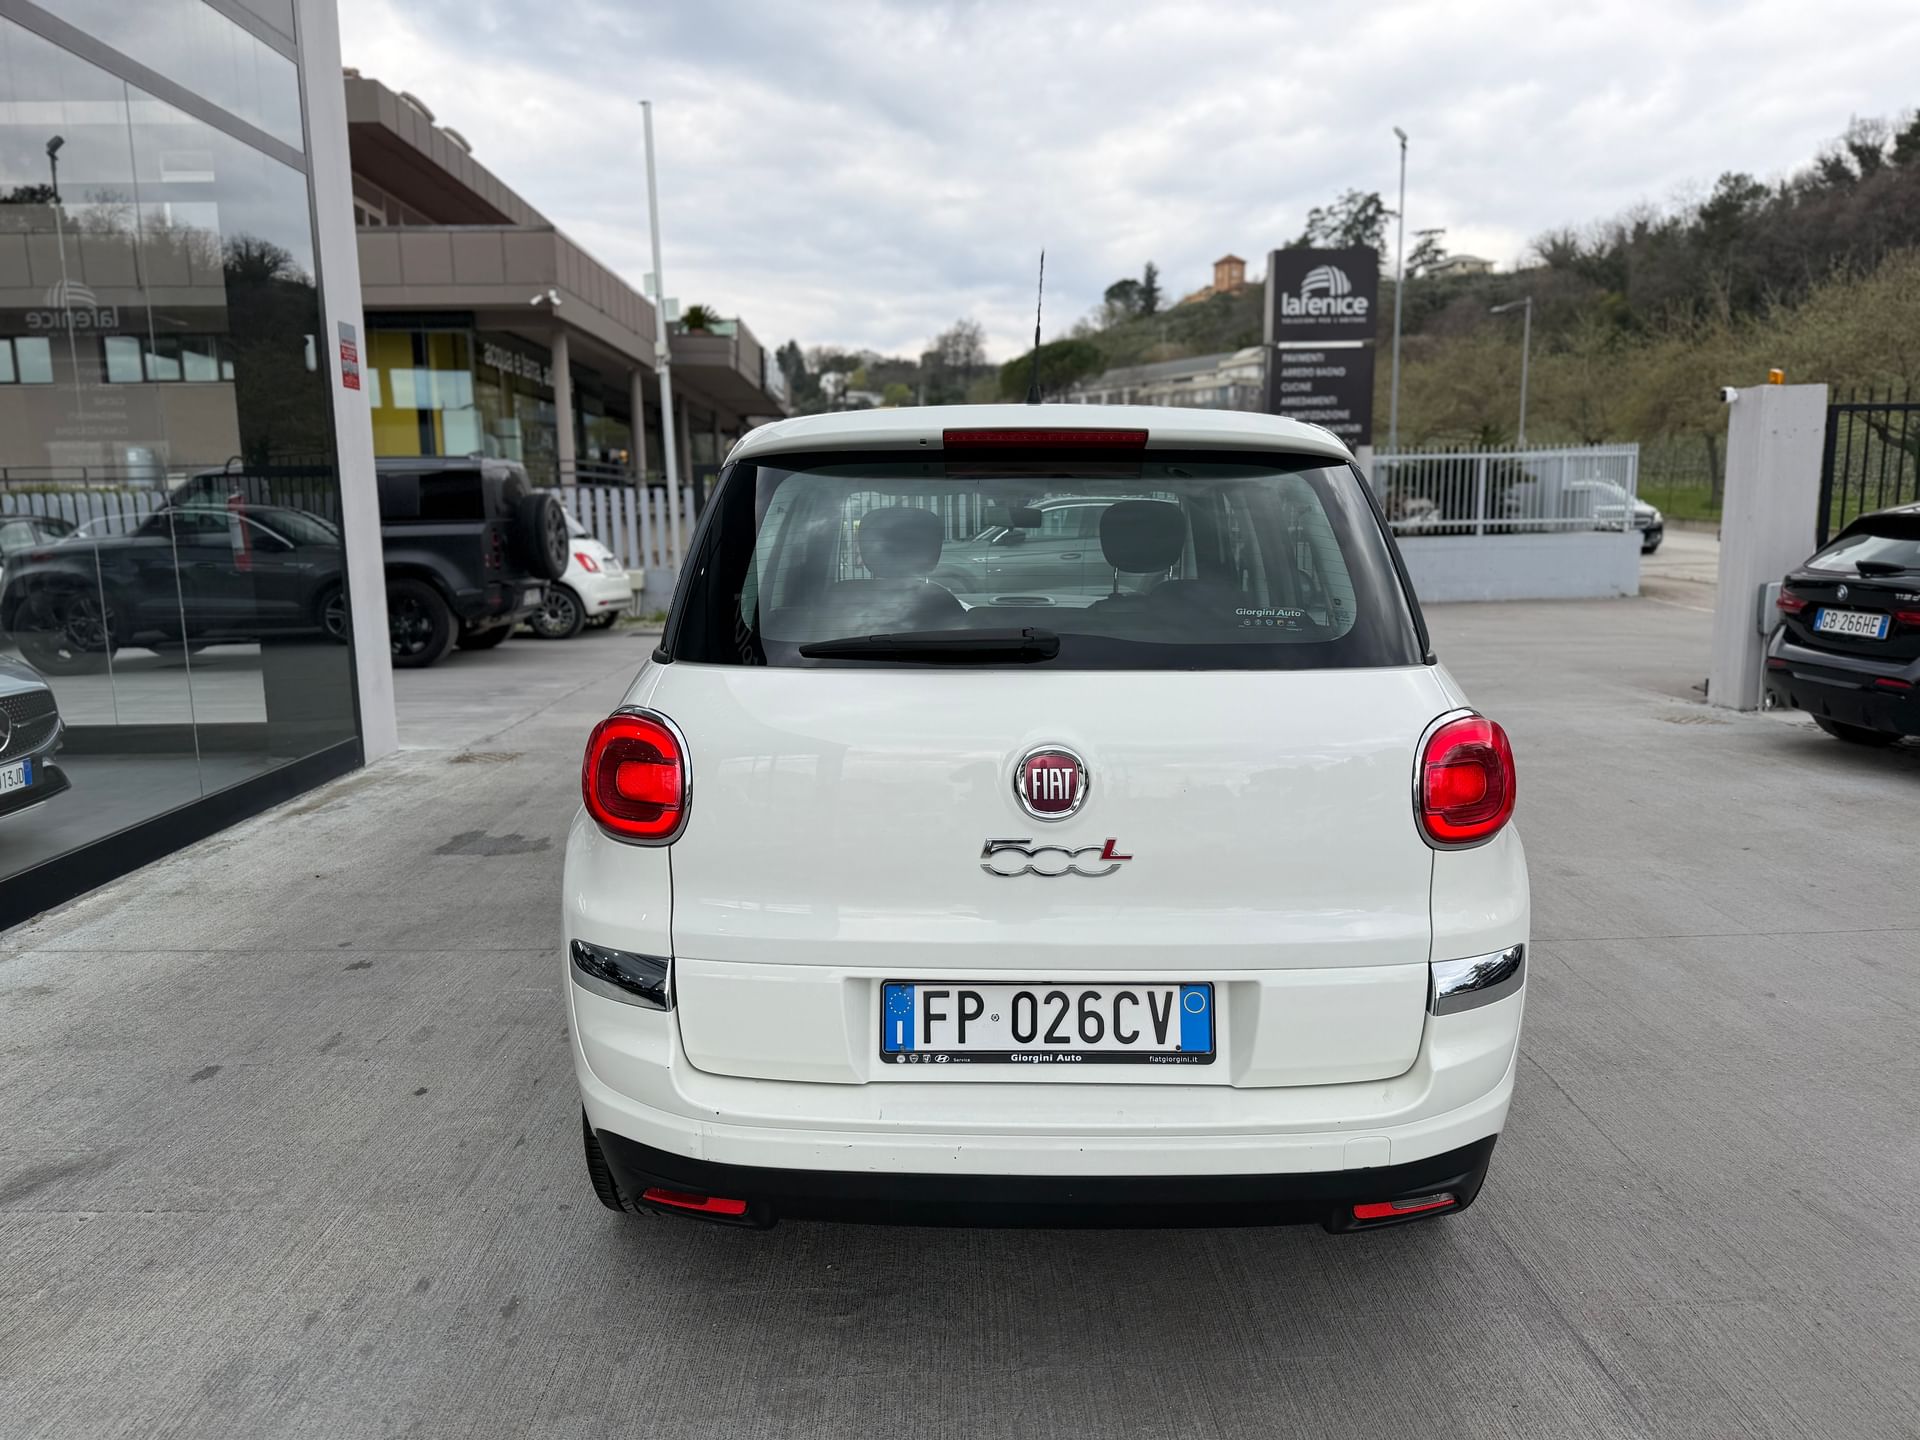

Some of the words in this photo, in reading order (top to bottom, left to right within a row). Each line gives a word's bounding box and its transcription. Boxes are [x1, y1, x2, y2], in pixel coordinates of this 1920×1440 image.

[1281, 292, 1368, 316] lafenice
[1235, 608, 1275, 618] Giorgini
[1277, 609, 1301, 617] Auto
[1822, 611, 1838, 629] GB
[1840, 614, 1880, 635] 266HE
[0, 767, 25, 790] 13JD
[1032, 768, 1073, 800] FIAT
[980, 837, 1134, 878] 500L
[923, 990, 985, 1044] FP
[1011, 990, 1174, 1045] 026CV
[1010, 1054, 1053, 1063] Giorgini
[1056, 1054, 1082, 1062] Auto
[1149, 1055, 1198, 1064] fiatgiorgini.it
